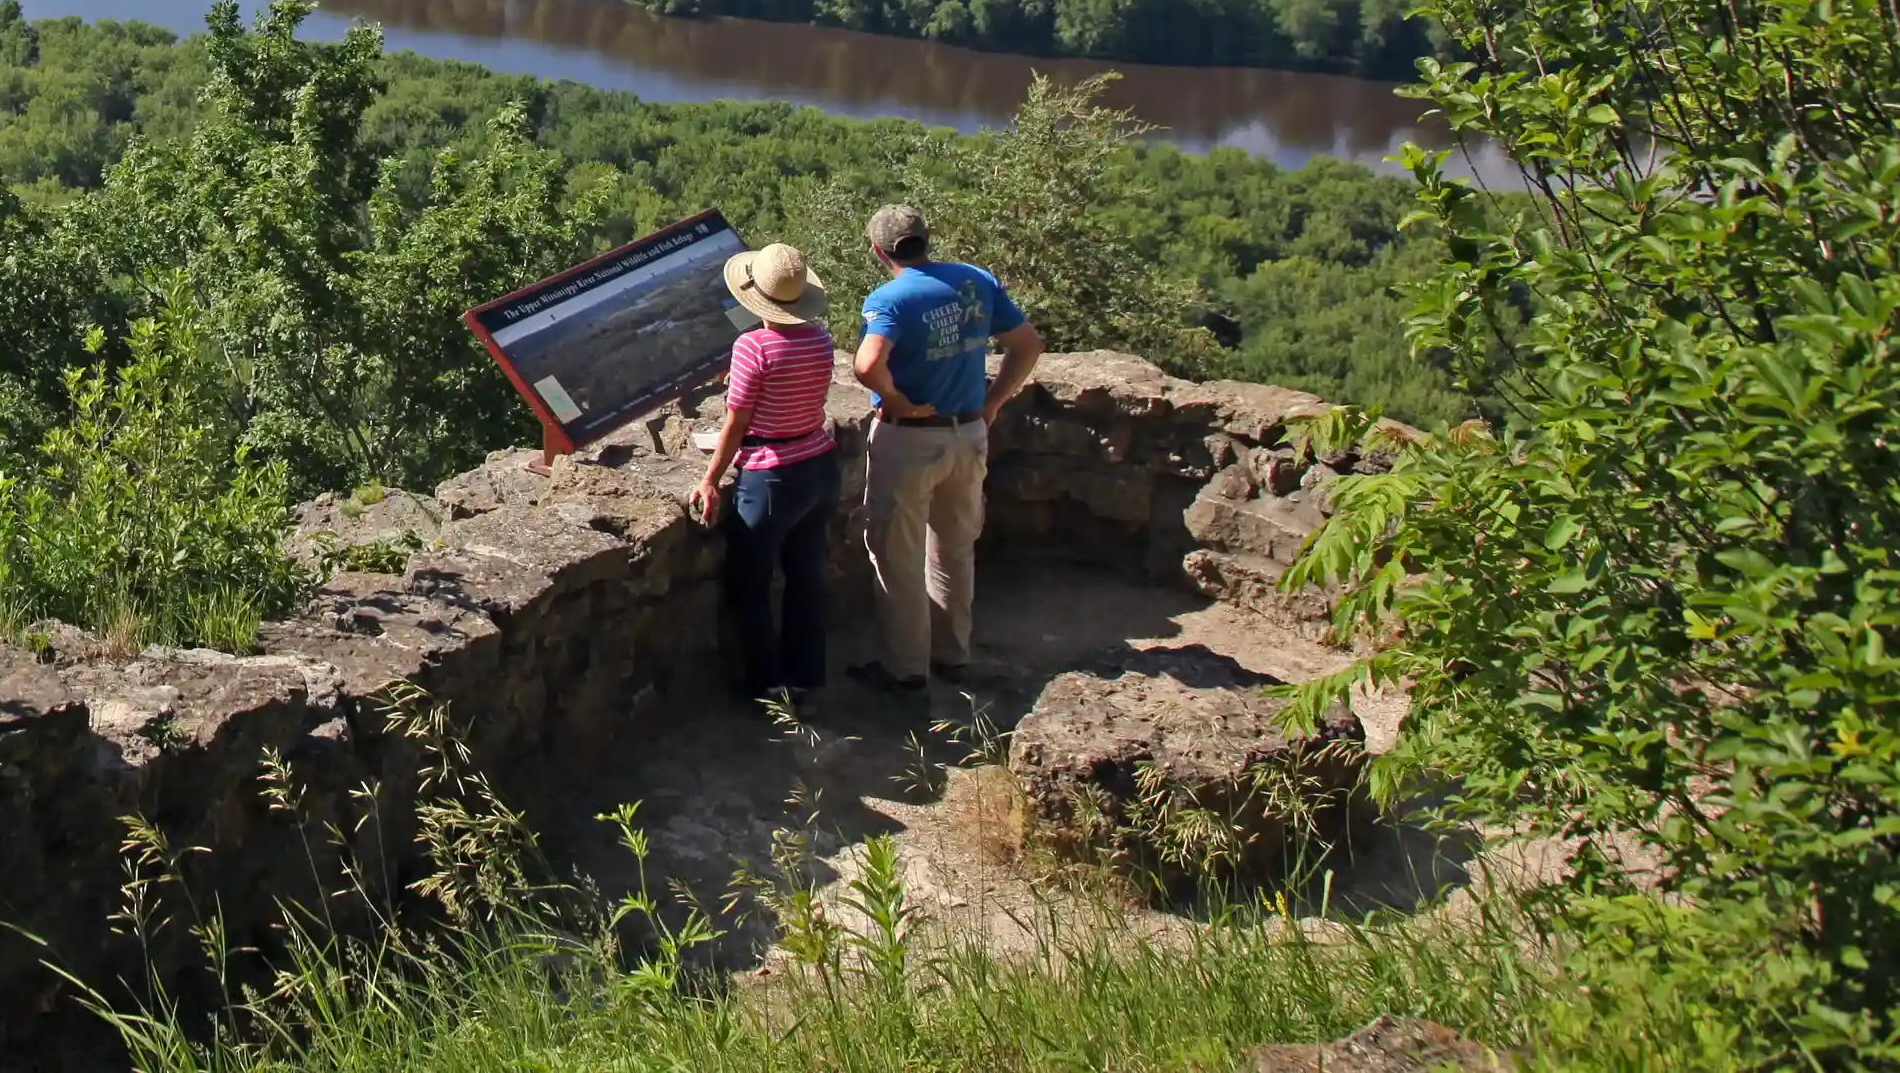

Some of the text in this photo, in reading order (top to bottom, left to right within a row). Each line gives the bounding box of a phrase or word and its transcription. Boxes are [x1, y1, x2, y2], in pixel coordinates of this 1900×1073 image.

[504, 233, 693, 319] The Upper Mississippi River National Wildlife and Fish Refuge
[940, 324, 959, 337] FOR
[939, 333, 960, 346] OLD
